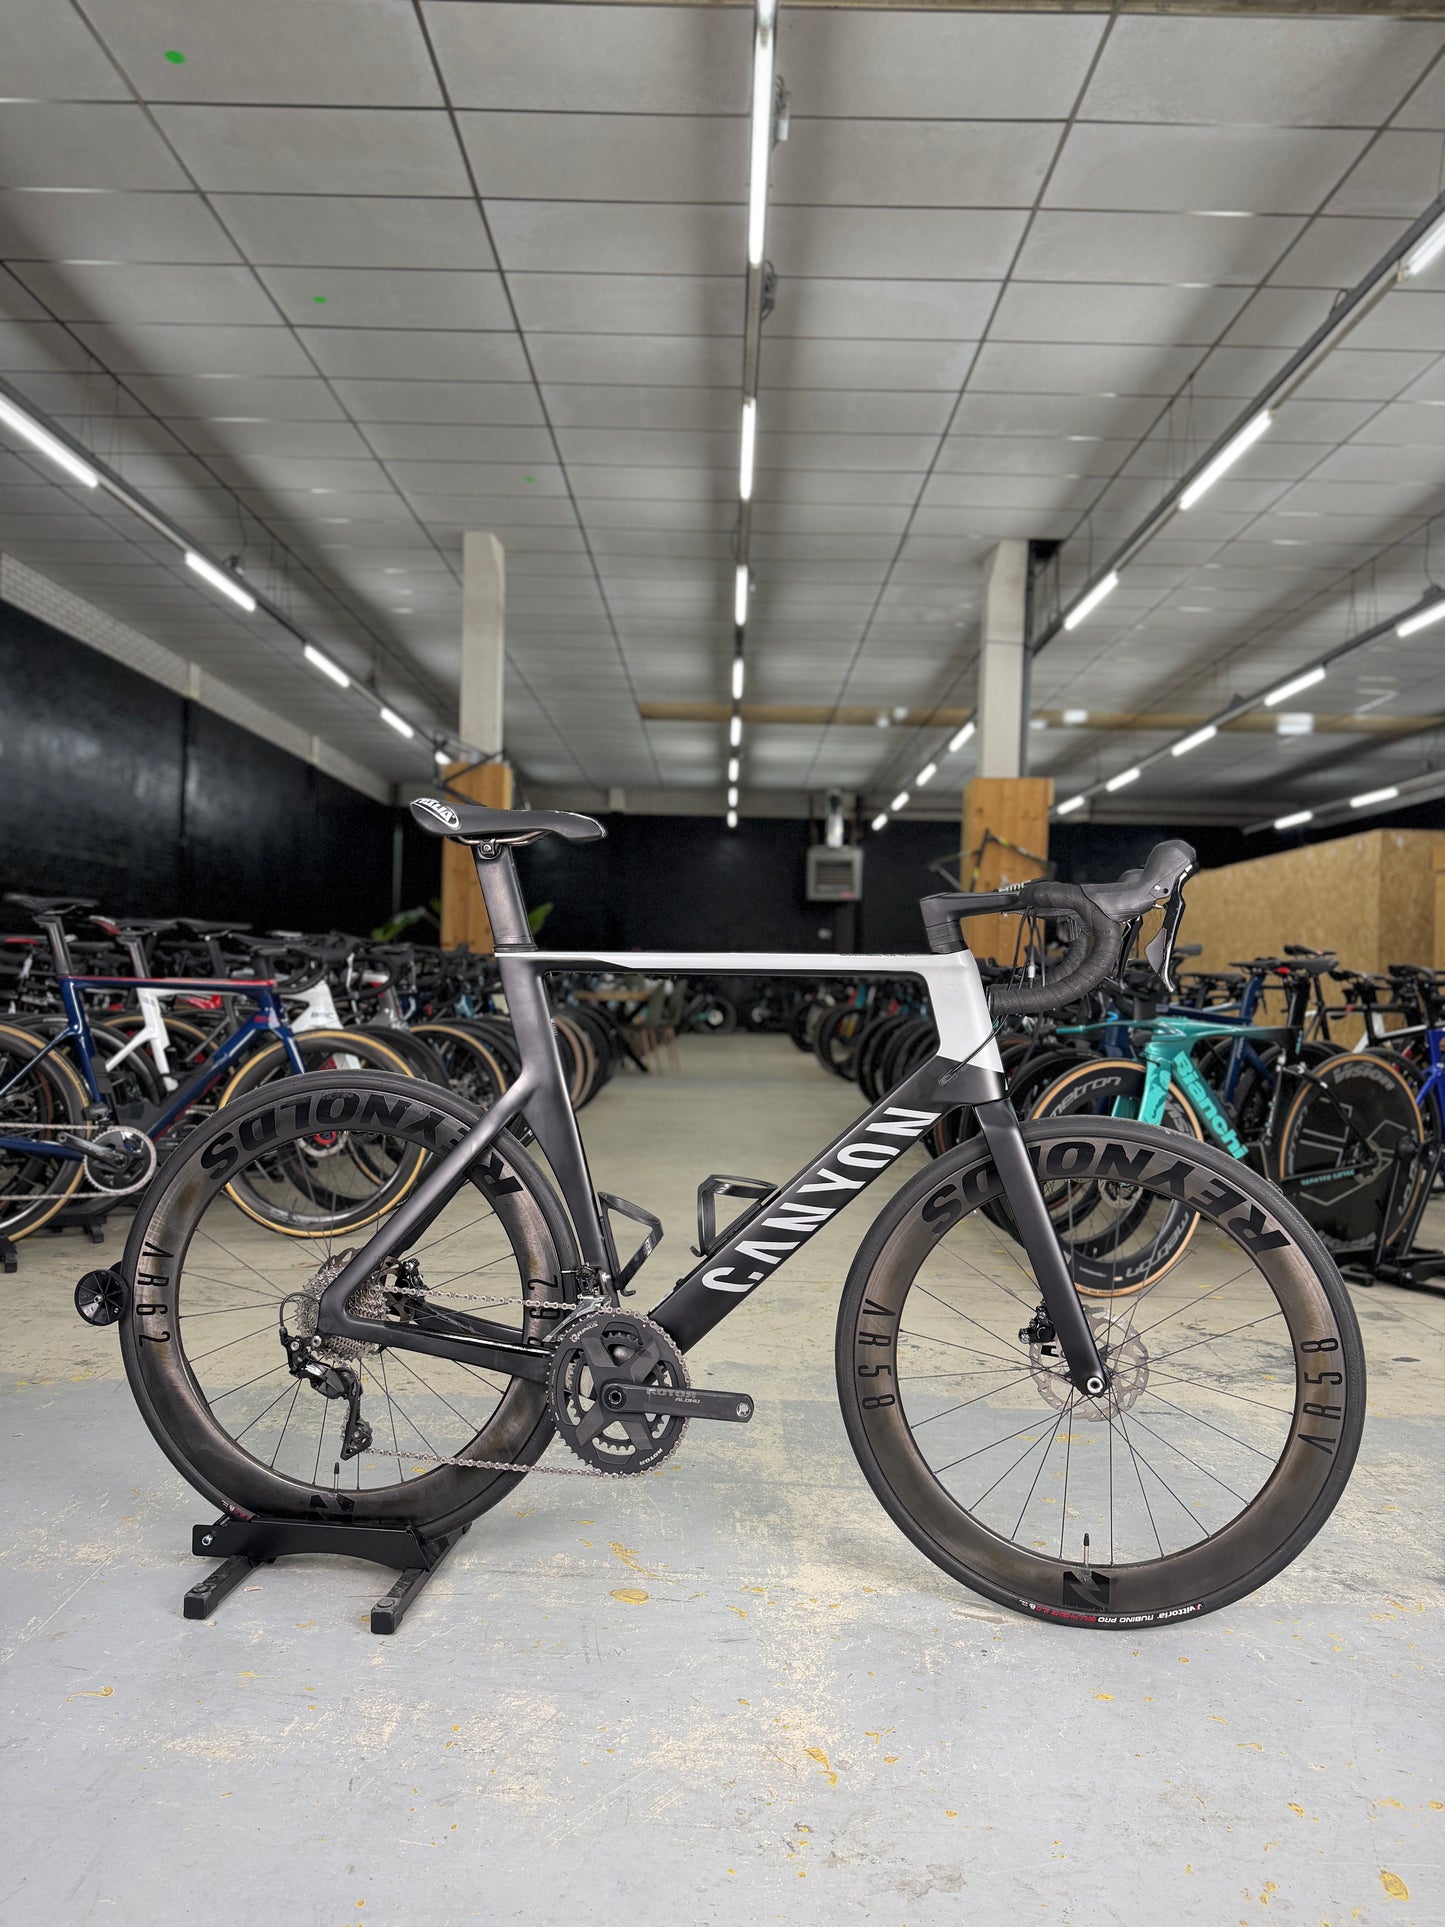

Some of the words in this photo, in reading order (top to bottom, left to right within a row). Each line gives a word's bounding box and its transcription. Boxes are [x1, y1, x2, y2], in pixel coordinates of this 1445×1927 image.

[1049, 1076, 1122, 1118] metron
[1173, 1051, 1249, 1160] Bianchi
[702, 1107, 942, 1293] CANYON
[1125, 1212, 1190, 1278] metron
[1097, 1616, 1118, 1624] PRO
